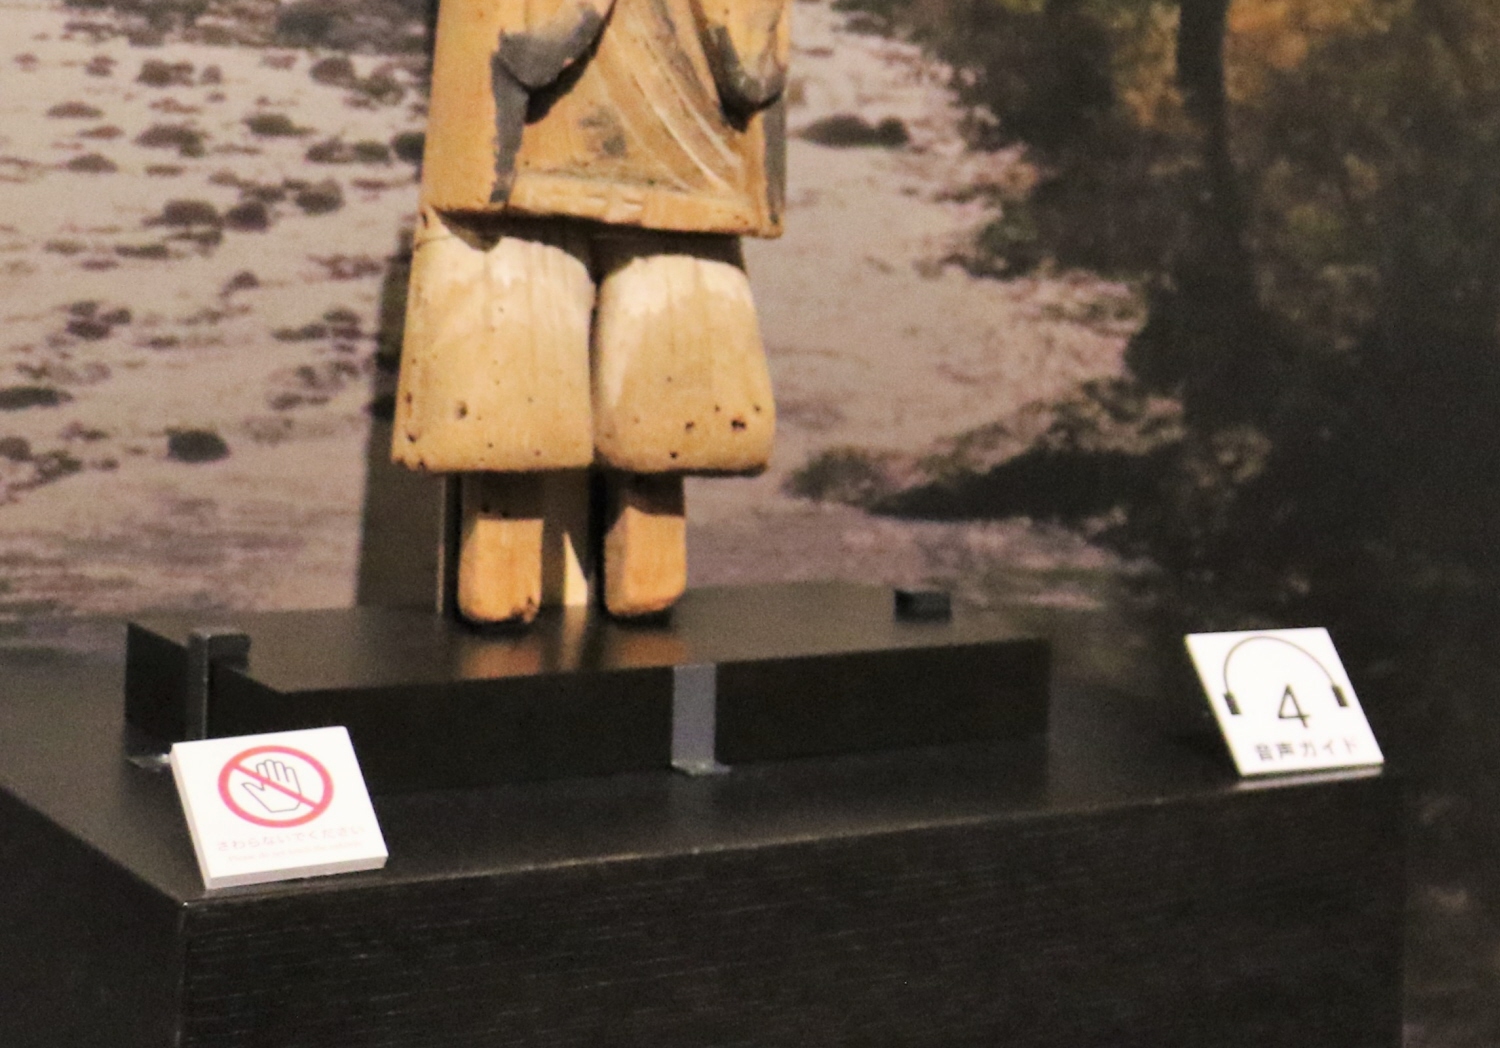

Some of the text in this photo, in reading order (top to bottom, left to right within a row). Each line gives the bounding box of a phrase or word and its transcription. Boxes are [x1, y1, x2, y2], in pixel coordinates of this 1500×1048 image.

[1278, 684, 1310, 728] 4
[1255, 737, 1357, 761] 音声ガイド
